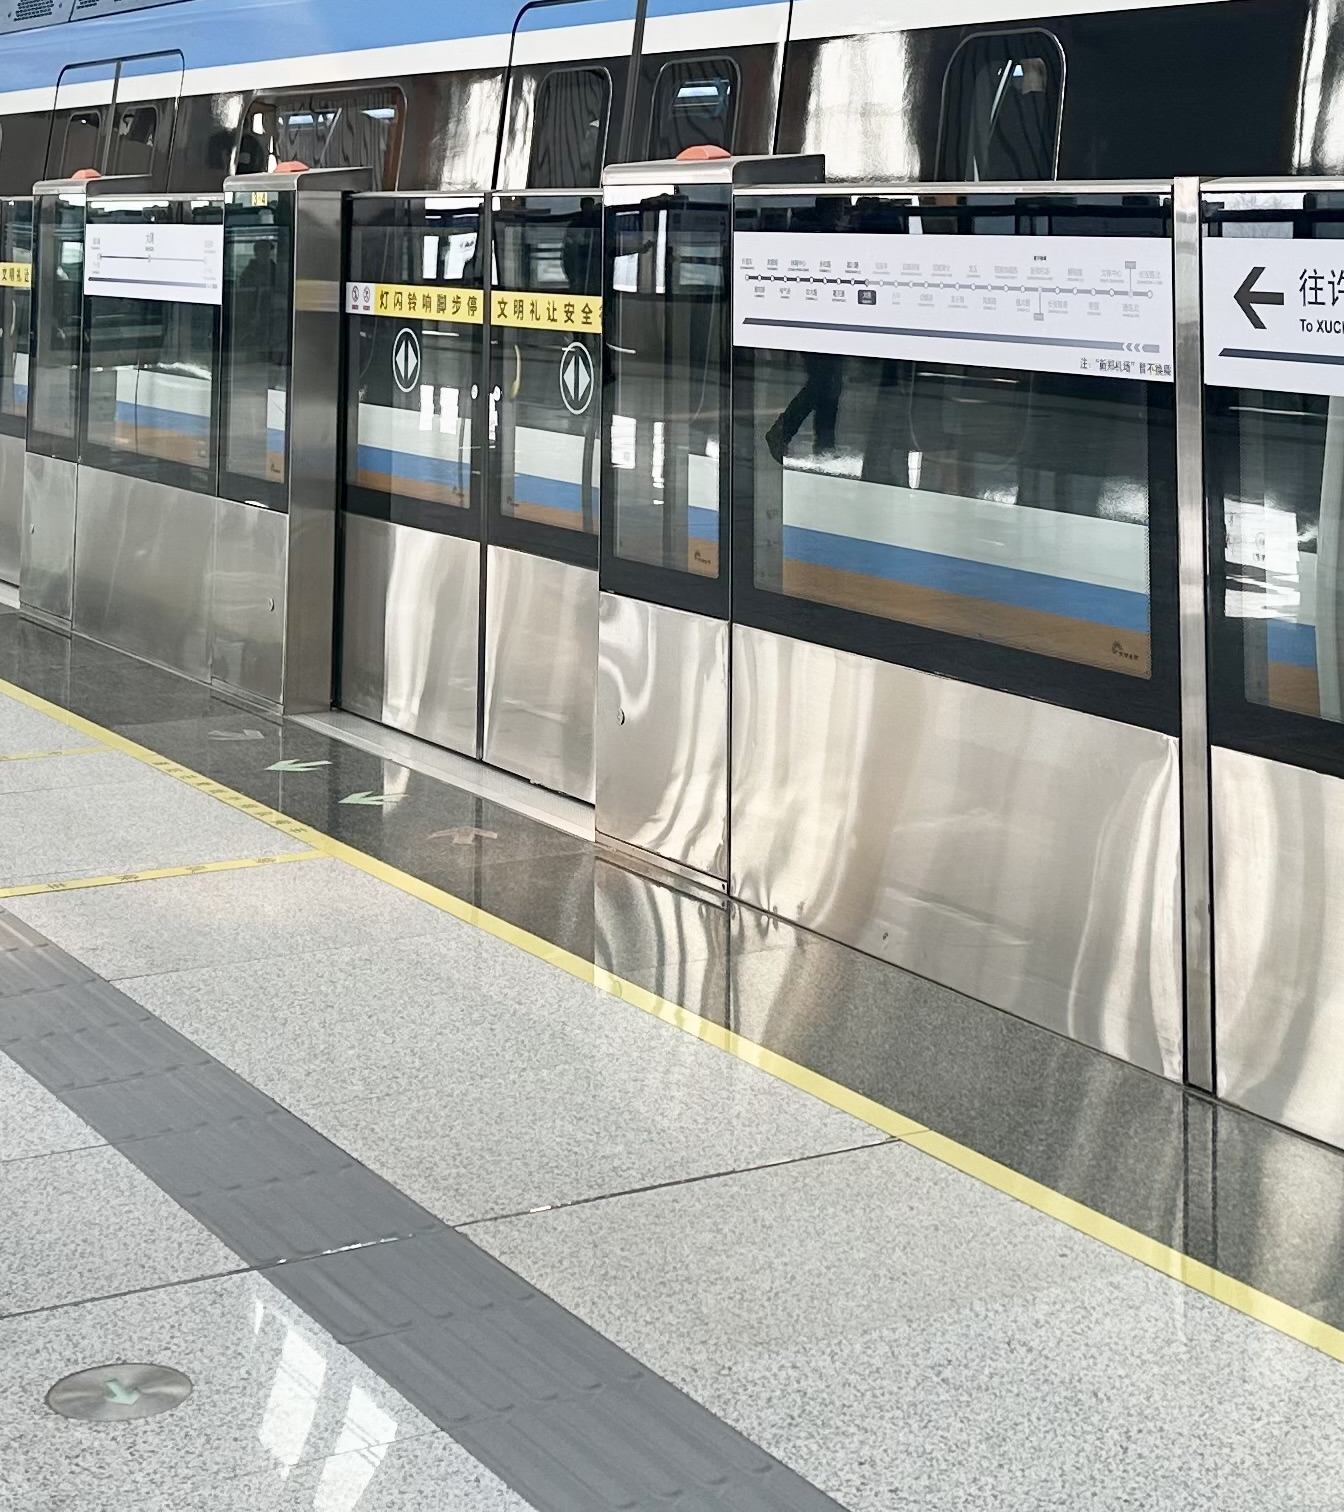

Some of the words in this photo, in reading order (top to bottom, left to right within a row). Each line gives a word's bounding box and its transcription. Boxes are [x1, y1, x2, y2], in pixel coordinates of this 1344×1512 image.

[379, 290, 478, 317] 灯闪铃响脚步停
[497, 297, 602, 326] 文明礼让安全
[1299, 319, 1313, 333] To
